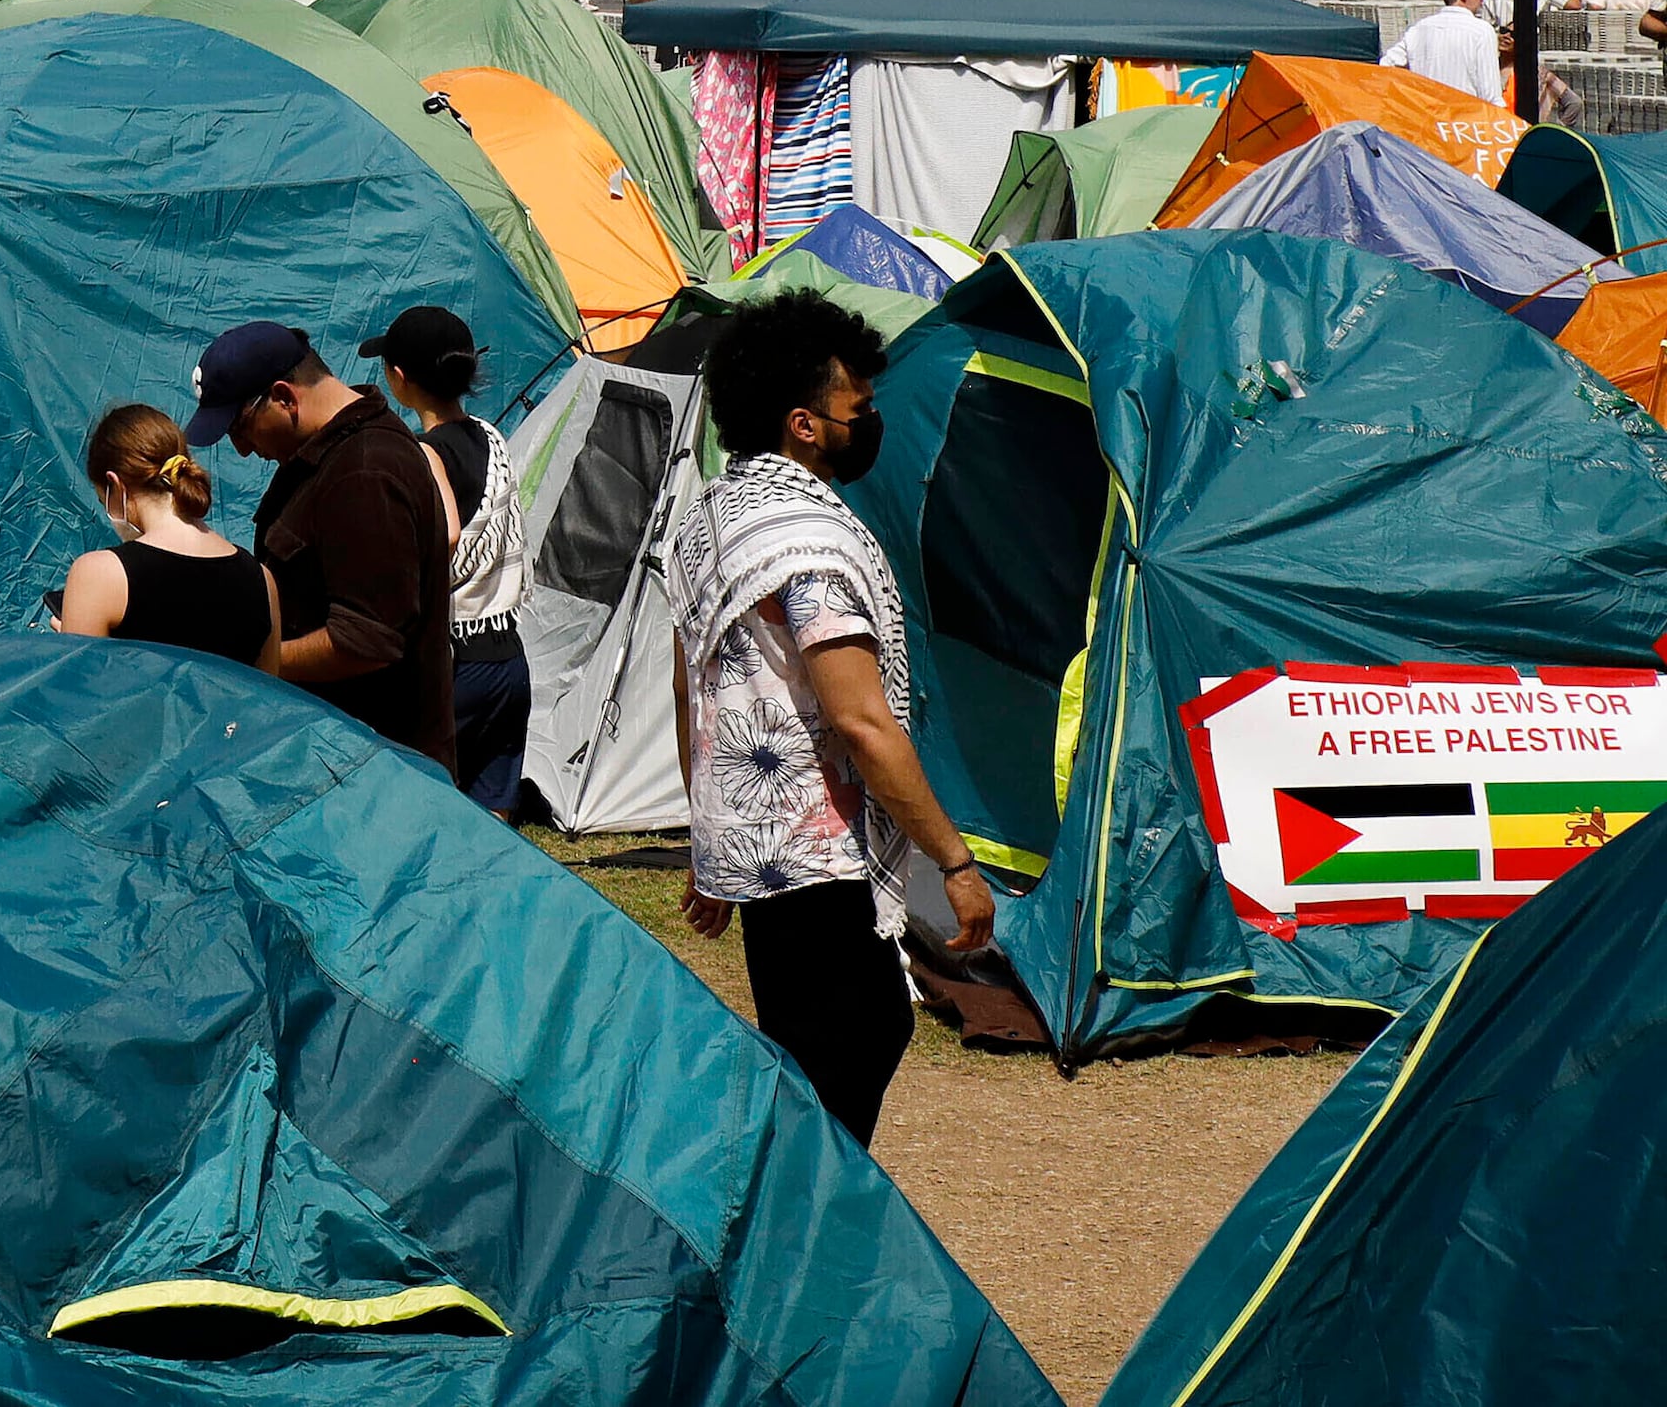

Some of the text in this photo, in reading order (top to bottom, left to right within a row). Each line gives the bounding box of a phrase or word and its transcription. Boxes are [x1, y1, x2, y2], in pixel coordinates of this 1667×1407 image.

[1436, 119, 1528, 145] FRESH
[1288, 691, 1631, 718] ETHIOPIAN JEWS FOR
[1318, 727, 1621, 756] A FREE PALESTINE
